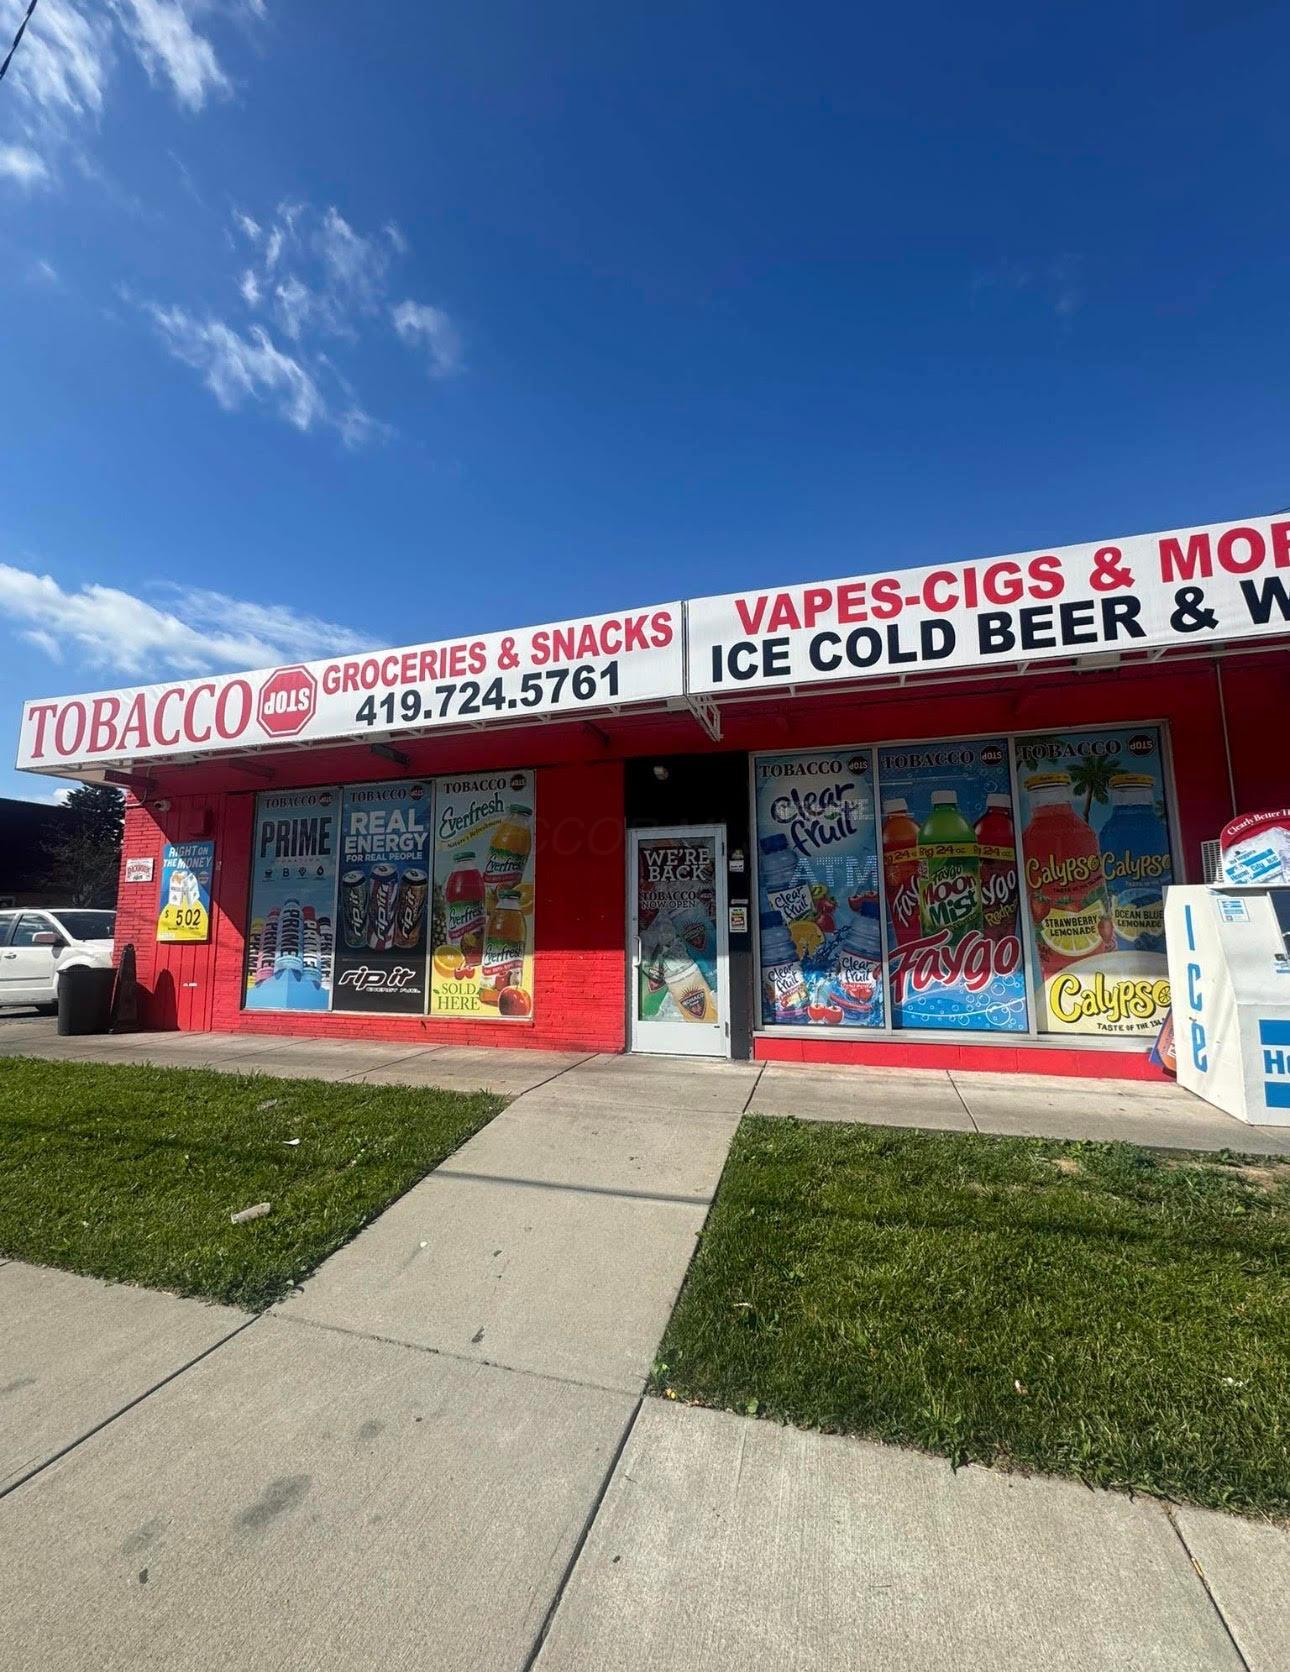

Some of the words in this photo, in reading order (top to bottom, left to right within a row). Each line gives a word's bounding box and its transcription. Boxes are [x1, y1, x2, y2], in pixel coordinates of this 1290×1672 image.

[735, 556, 1065, 636] VAPES-CIGS
[1089, 546, 1136, 592] &
[711, 636, 791, 683] ICE
[809, 618, 956, 672] COLD
[977, 594, 1147, 655] BEER
[1170, 586, 1219, 633] &
[322, 641, 487, 695] GROCERIES
[497, 636, 520, 670] &
[531, 610, 674, 665] SNACKS
[263, 687, 310, 714] STOP
[356, 660, 620, 726] 419.724.5761
[28, 679, 253, 758] TOBACCO
[882, 749, 975, 769] TOBACCO
[981, 751, 1002, 760] STOP
[1017, 738, 1122, 760] TOBACCO
[1129, 741, 1153, 750] STOP
[759, 760, 843, 778] TOBACCO
[849, 760, 868, 770] STOP
[351, 789, 407, 802] TOBACCO
[443, 777, 507, 794] TOBACCO
[264, 795, 316, 809] TOBACCO
[770, 783, 855, 824] Clear
[350, 808, 424, 835] REAL
[439, 791, 505, 839] Everfresh
[1227, 817, 1253, 835] Clearly
[1253, 810, 1280, 822] Better
[260, 817, 332, 858] PRIME
[789, 800, 858, 857] fruit
[169, 846, 197, 857] RIGHT
[198, 846, 209, 855] ON
[345, 832, 428, 854] ENERGY
[919, 846, 934, 857] Big
[936, 846, 953, 855] 24
[983, 846, 1000, 856] 24
[163, 858, 177, 868] THE
[177, 856, 212, 869] MONEY
[346, 854, 364, 863] FOR
[364, 853, 388, 862] REAL
[388, 851, 423, 861] PEOPLE
[643, 848, 710, 866] WE'RE
[894, 850, 910, 859] 24
[1102, 849, 1172, 881] Calypso
[648, 865, 706, 882] BACK
[789, 855, 878, 888] ATM
[932, 864, 962, 882] Faygo
[1025, 854, 1101, 889] Calypso
[641, 890, 697, 901] TOBACCO
[642, 900, 666, 909] NOW
[668, 900, 696, 908] OPEN
[774, 886, 804, 908] Clear
[783, 893, 809, 921] fruit
[1114, 909, 1141, 919] OCEAN
[1044, 914, 1098, 929] STRAWBERRY
[1050, 926, 1096, 938] LEMONADE
[1117, 919, 1162, 928] LEMONADE
[280, 909, 300, 958] PRIME
[304, 920, 318, 968] PRIME
[768, 963, 794, 983] Clear
[842, 956, 875, 971] Clear
[885, 929, 1020, 1003] Faygo
[338, 966, 387, 991] rip
[387, 966, 416, 987] it
[776, 970, 799, 993] fruit
[845, 968, 871, 983] fruit
[441, 983, 477, 996] SOLD
[1050, 971, 1172, 1023] Calypso
[437, 995, 480, 1011] HERE
[1096, 1022, 1124, 1032] TASTE
[1151, 1017, 1166, 1028] ISL
[1263, 1050, 1290, 1075] H
